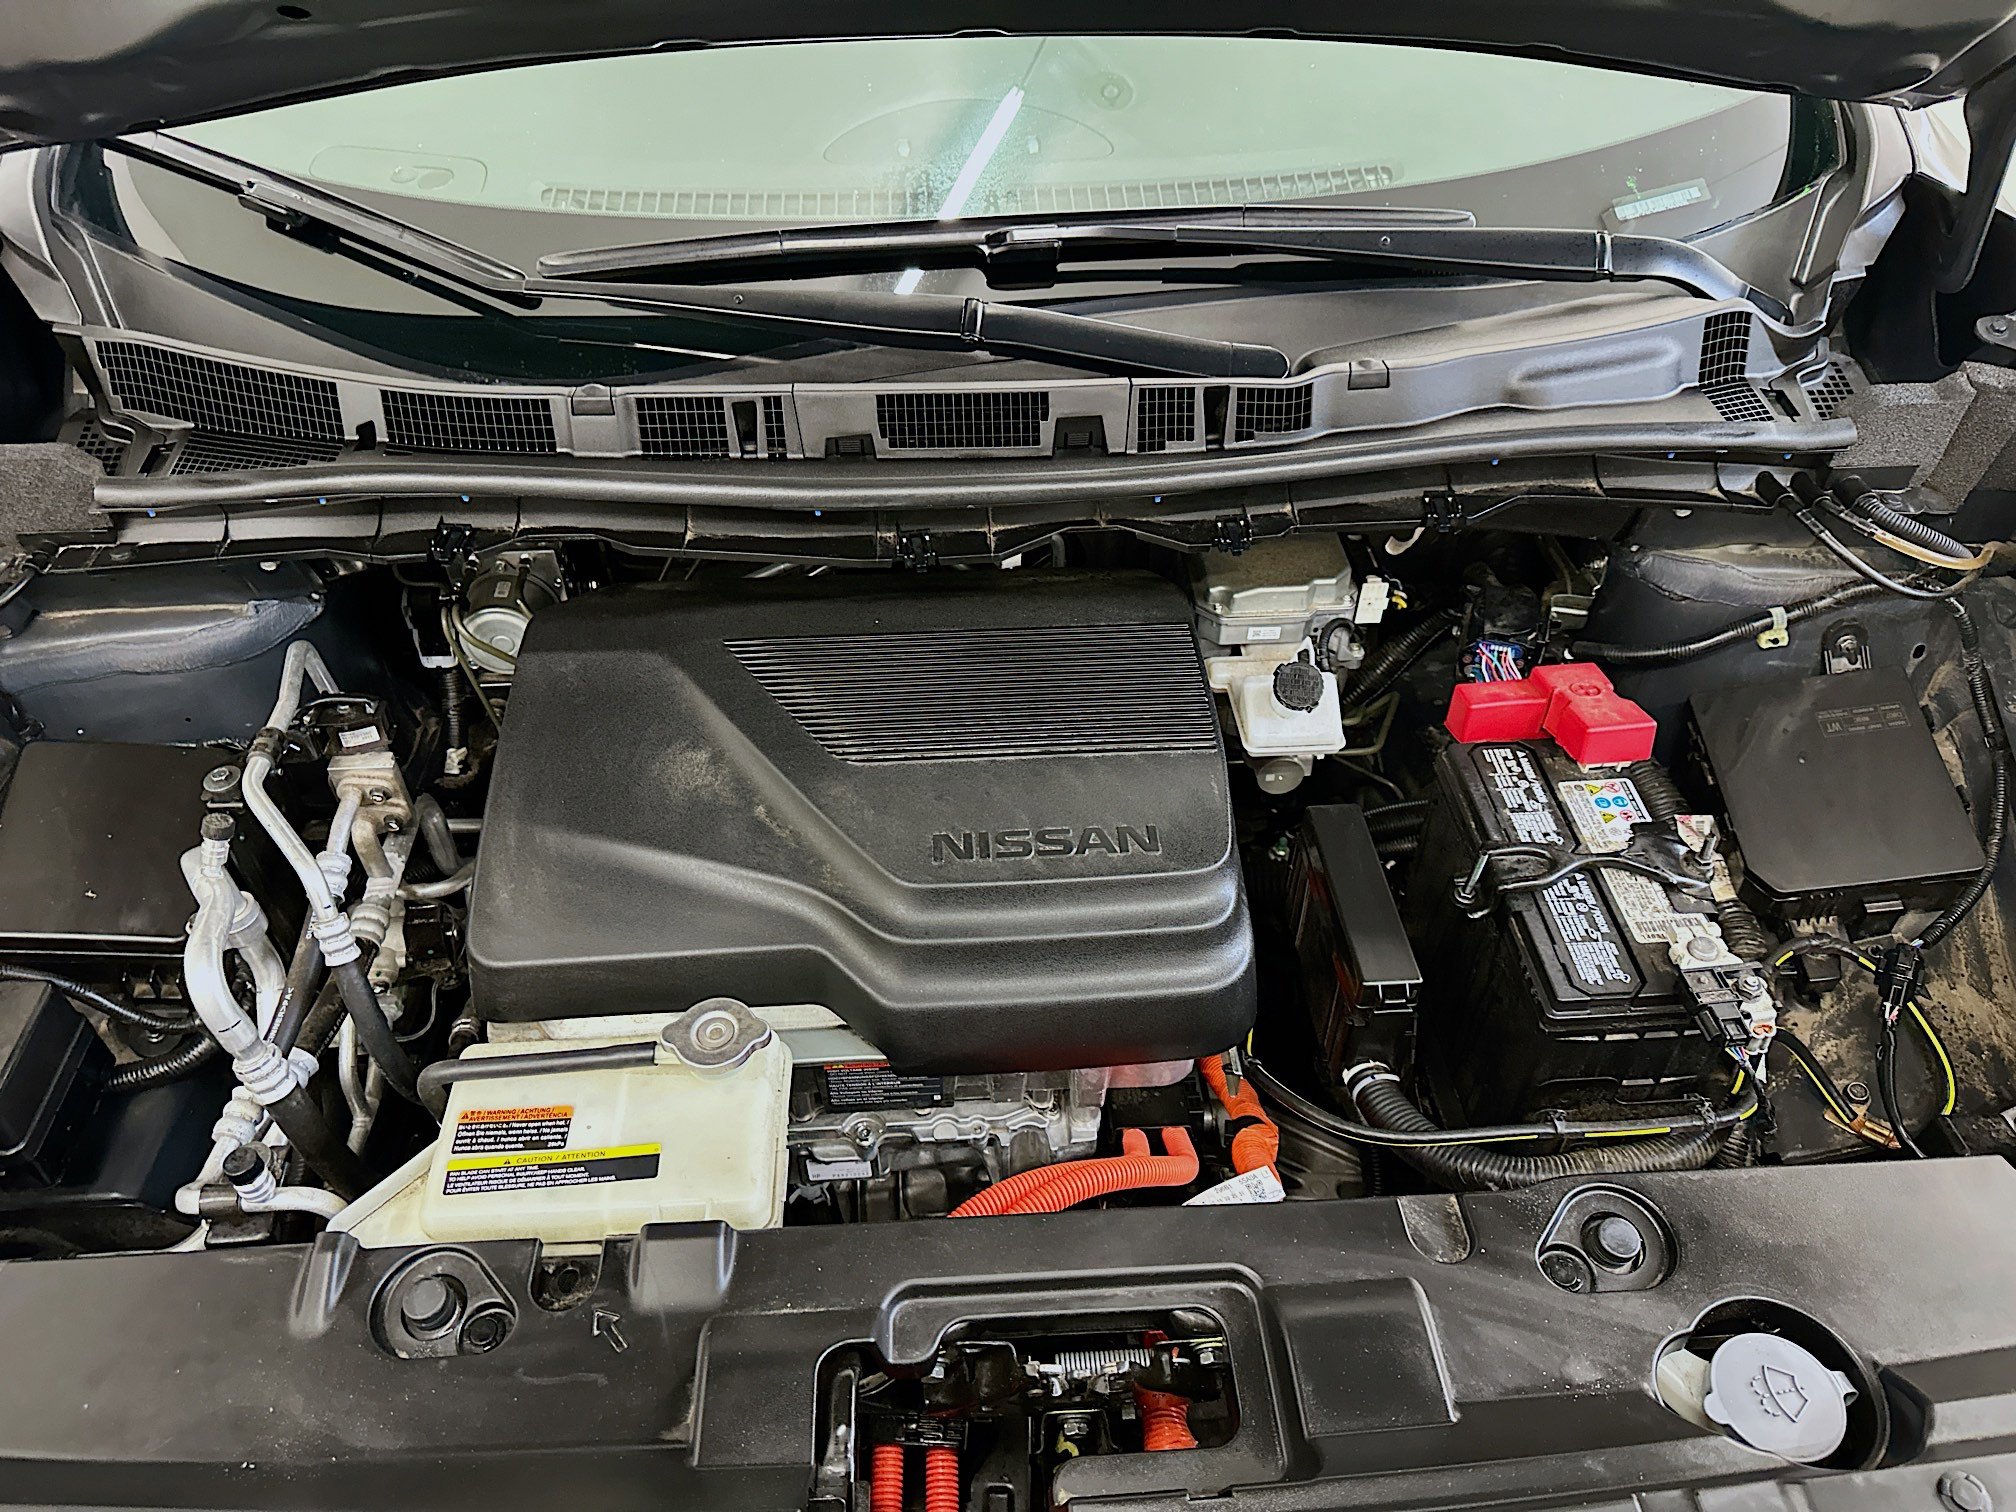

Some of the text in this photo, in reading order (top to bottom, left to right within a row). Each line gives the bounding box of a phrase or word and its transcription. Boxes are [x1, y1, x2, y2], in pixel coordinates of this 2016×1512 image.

[932, 824, 1161, 864] NISSAN
[516, 1155, 553, 1164] CAUTION
[561, 1151, 606, 1160] ATTENTION
